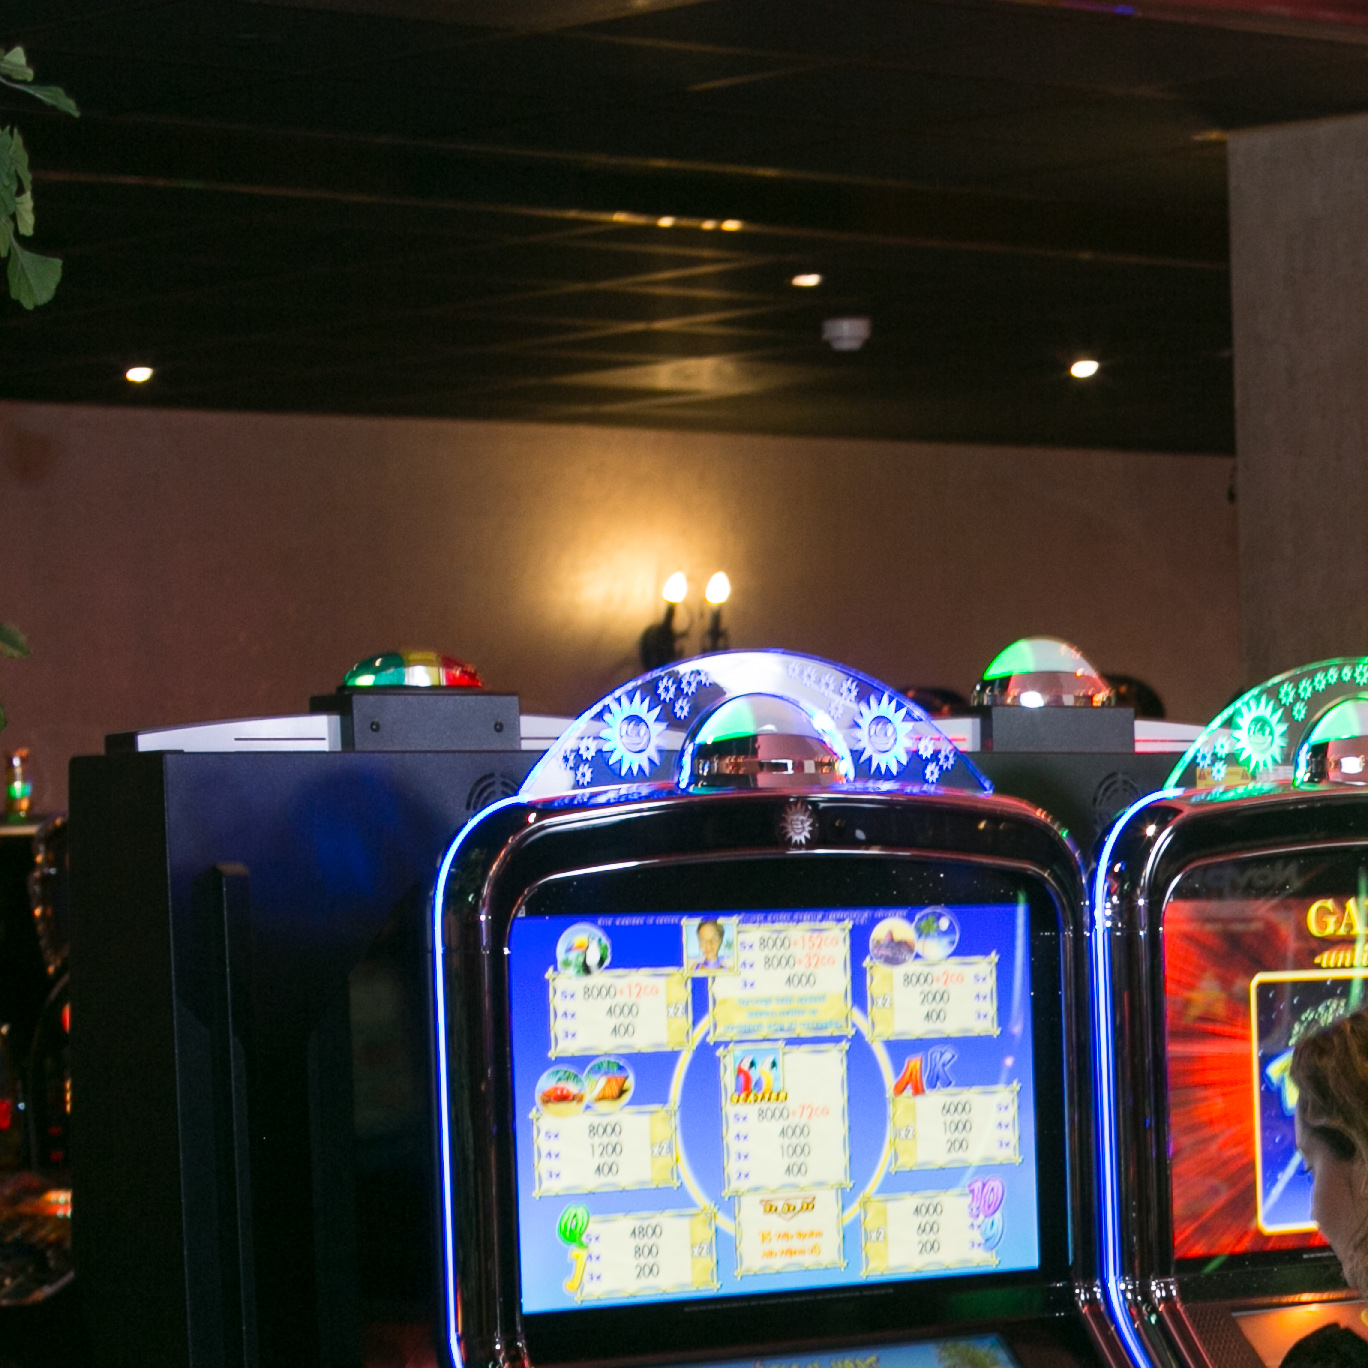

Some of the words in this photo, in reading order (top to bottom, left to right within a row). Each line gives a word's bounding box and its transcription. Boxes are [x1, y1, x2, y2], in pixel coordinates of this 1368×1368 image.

[785, 973, 816, 988] 4000
[919, 991, 950, 1005] 2000
[606, 1004, 639, 1018] 4000
[923, 1009, 946, 1023] 400
[610, 1023, 635, 1037] 400
[941, 1101, 972, 1116] 6000
[588, 1122, 622, 1138] 8000
[778, 1125, 810, 1140] 4000
[942, 1119, 972, 1135] 1000
[590, 1142, 622, 1158] 1200
[780, 1143, 810, 1159] 1000
[946, 1138, 969, 1153] 200
[594, 1162, 619, 1177] 400
[784, 1163, 808, 1177] 400
[912, 1202, 943, 1218] 4000
[630, 1224, 662, 1240] 4800
[916, 1221, 939, 1236] 600
[633, 1243, 659, 1258] 800
[918, 1239, 940, 1255] 200
[636, 1263, 660, 1278] 200
